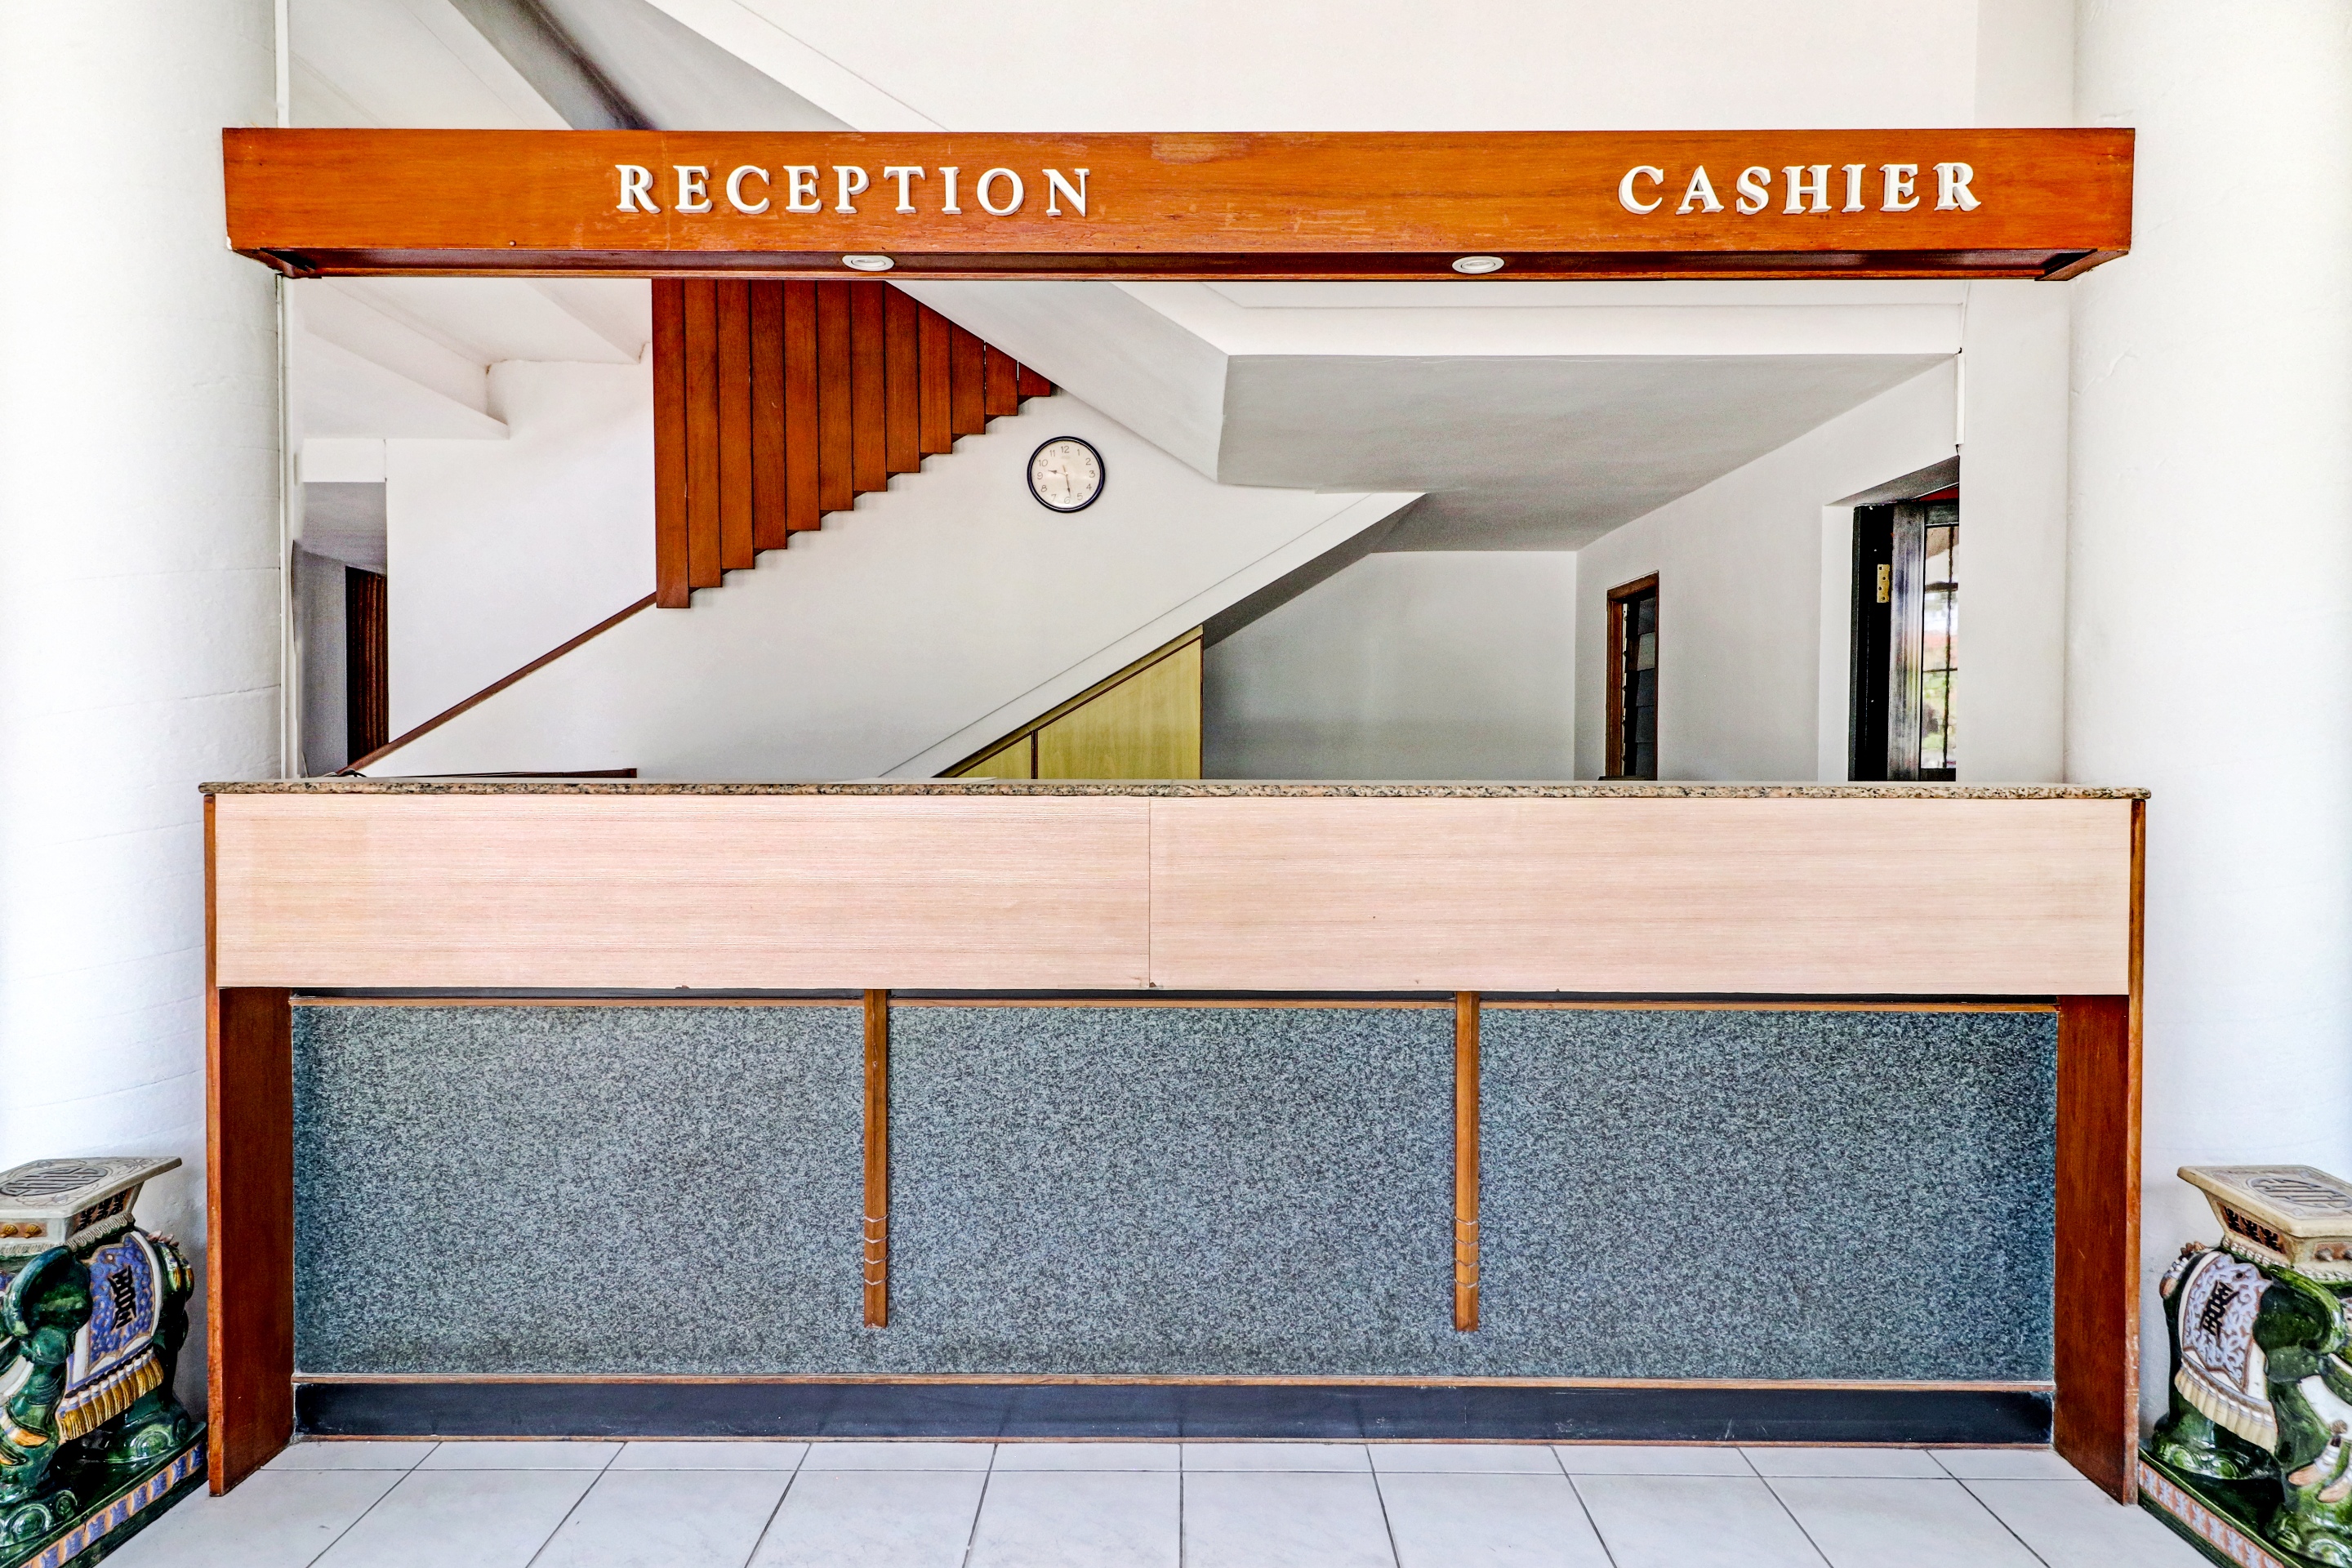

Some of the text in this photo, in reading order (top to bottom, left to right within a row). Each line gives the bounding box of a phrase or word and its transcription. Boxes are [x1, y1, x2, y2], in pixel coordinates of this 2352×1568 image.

[615, 164, 1089, 217] RECEPTION
[1618, 162, 1983, 216] CASHIER
[1049, 449, 1056, 457] 11
[1061, 445, 1070, 453] 12
[1038, 459, 1048, 467] 10
[1085, 457, 1091, 466] 2
[1036, 471, 1043, 479] 9
[1089, 470, 1095, 479] 3
[1040, 484, 1048, 492] 8
[1051, 493, 1057, 501] 7
[1076, 492, 1083, 501] 5
